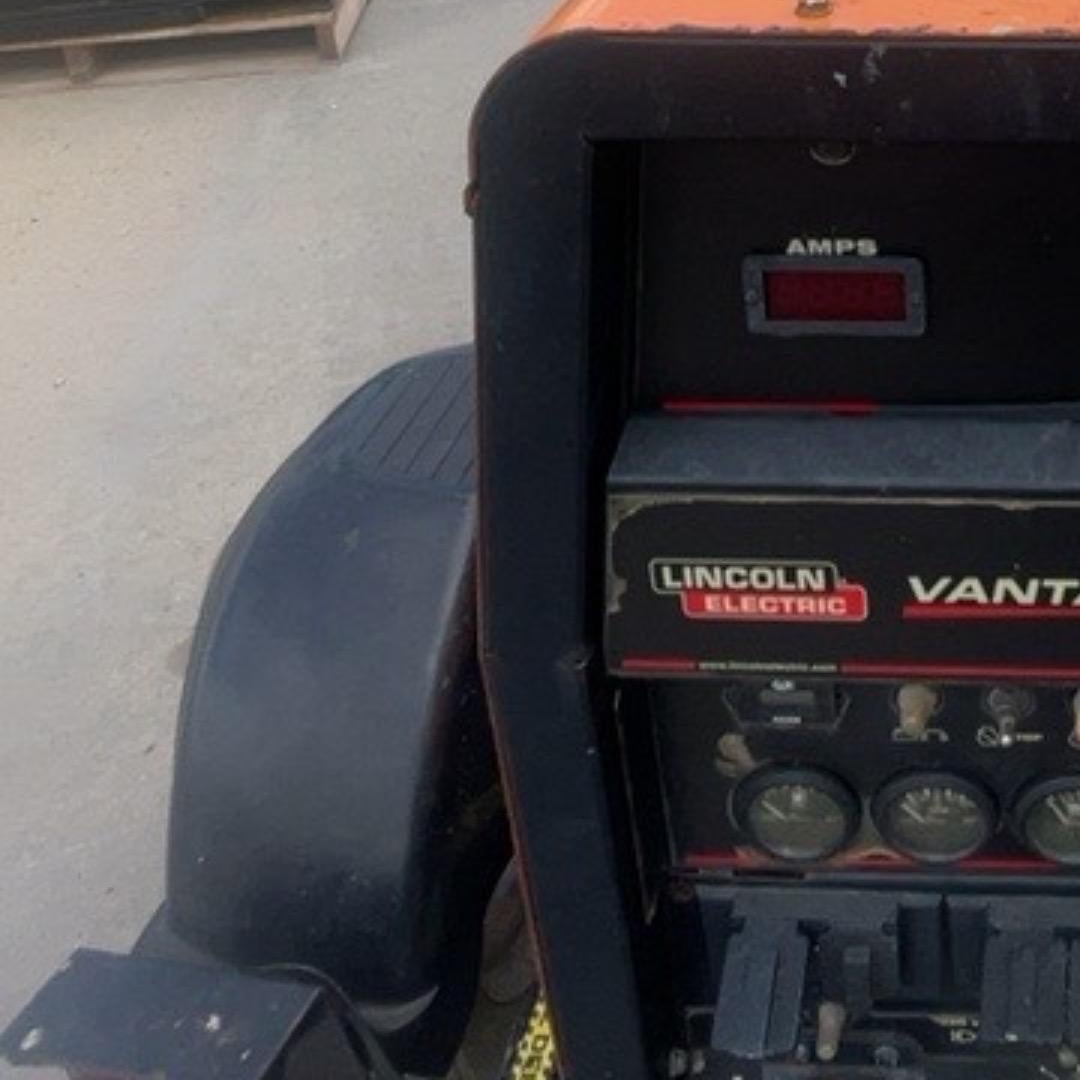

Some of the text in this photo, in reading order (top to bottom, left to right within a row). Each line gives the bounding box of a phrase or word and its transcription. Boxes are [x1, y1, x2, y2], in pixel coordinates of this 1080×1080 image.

[786, 237, 878, 257] AMPS
[661, 565, 825, 591] LINCOLN
[704, 593, 848, 615] ELECTRIC
